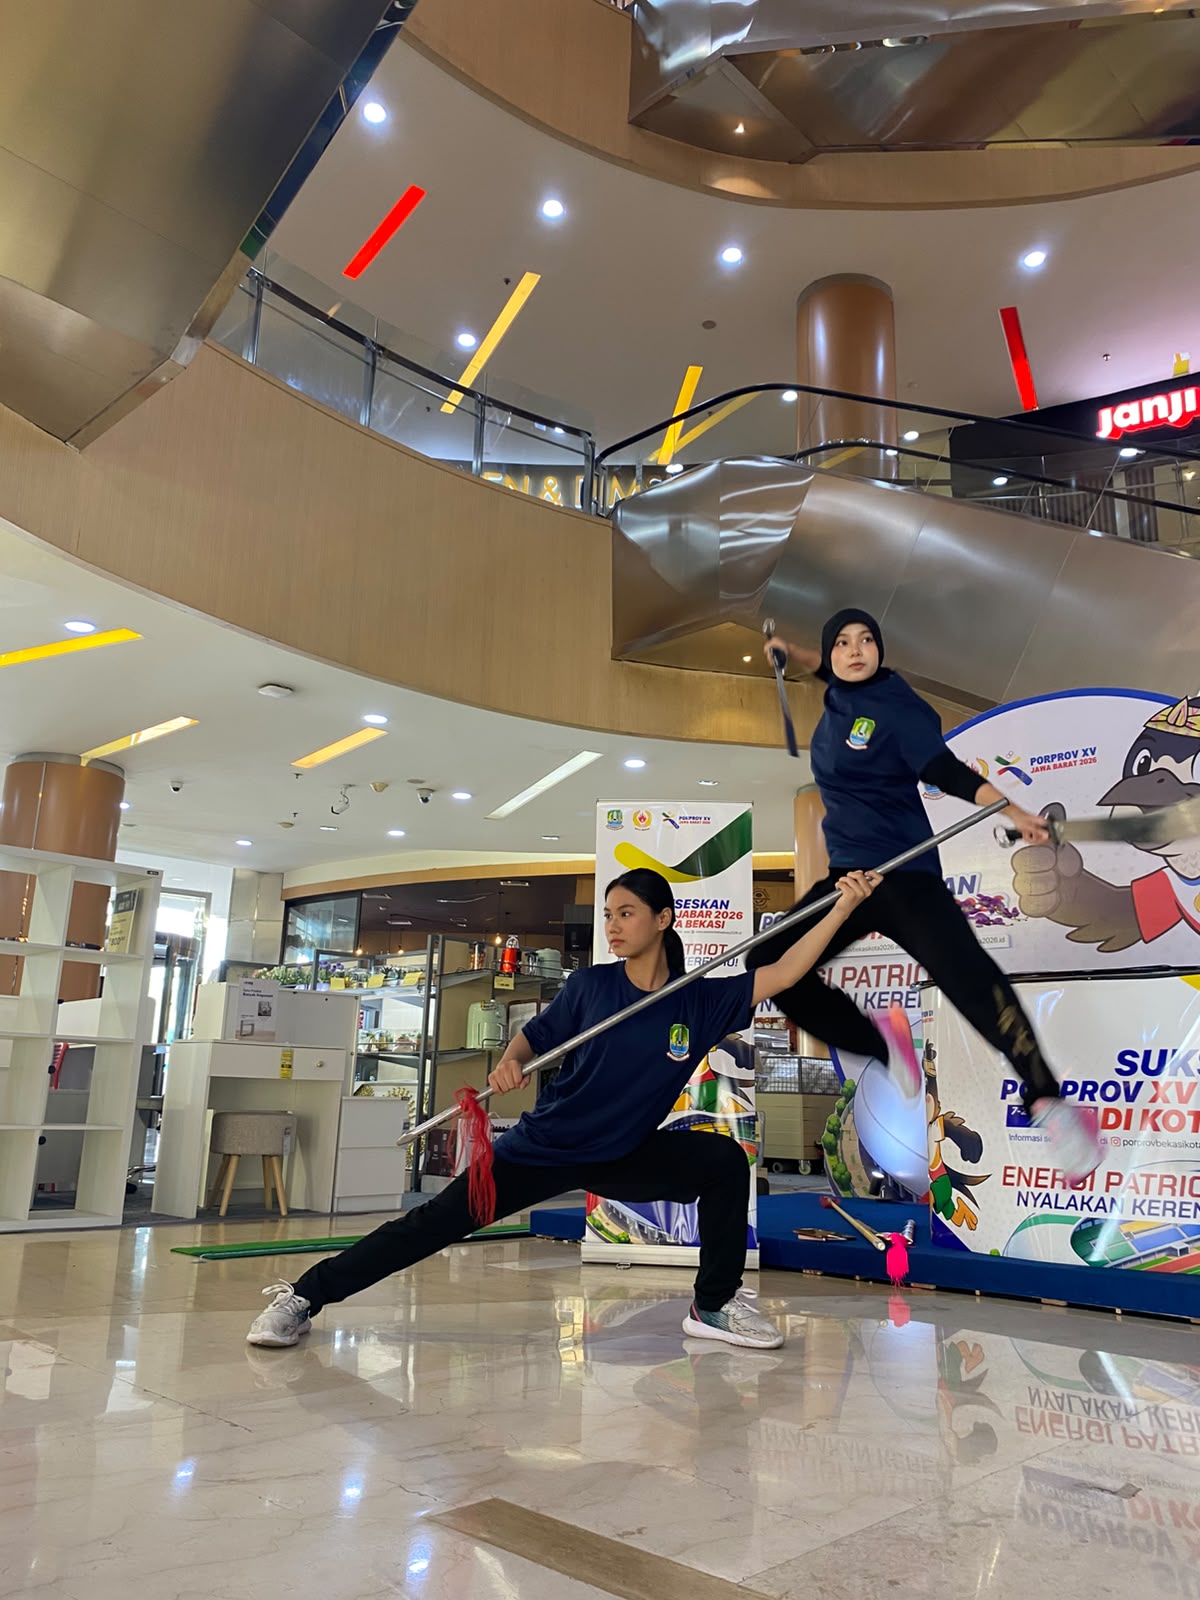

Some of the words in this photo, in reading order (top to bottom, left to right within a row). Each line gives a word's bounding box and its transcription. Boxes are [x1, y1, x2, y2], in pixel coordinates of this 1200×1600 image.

[1097, 387, 1196, 438] janji
[1030, 750, 1079, 766] PORPROV
[1081, 746, 1097, 757] XV
[1030, 765, 1051, 774] JAWA
[1052, 760, 1078, 770] BARAT
[1079, 757, 1097, 766] 2026
[674, 899, 730, 910] SESKAN
[675, 910, 713, 919] JABAR
[714, 911, 743, 920] 2026
[685, 920, 726, 929] BEKASI
[684, 943, 729, 956] TRIOT
[1115, 1048, 1200, 1077] SUK
[1000, 1079, 1144, 1104] PPROV
[1148, 1080, 1198, 1105] XV
[1101, 1107, 1133, 1131] DI
[1008, 1134, 1043, 1142] Informasi
[1016, 1191, 1124, 1214] NYALAKAN
